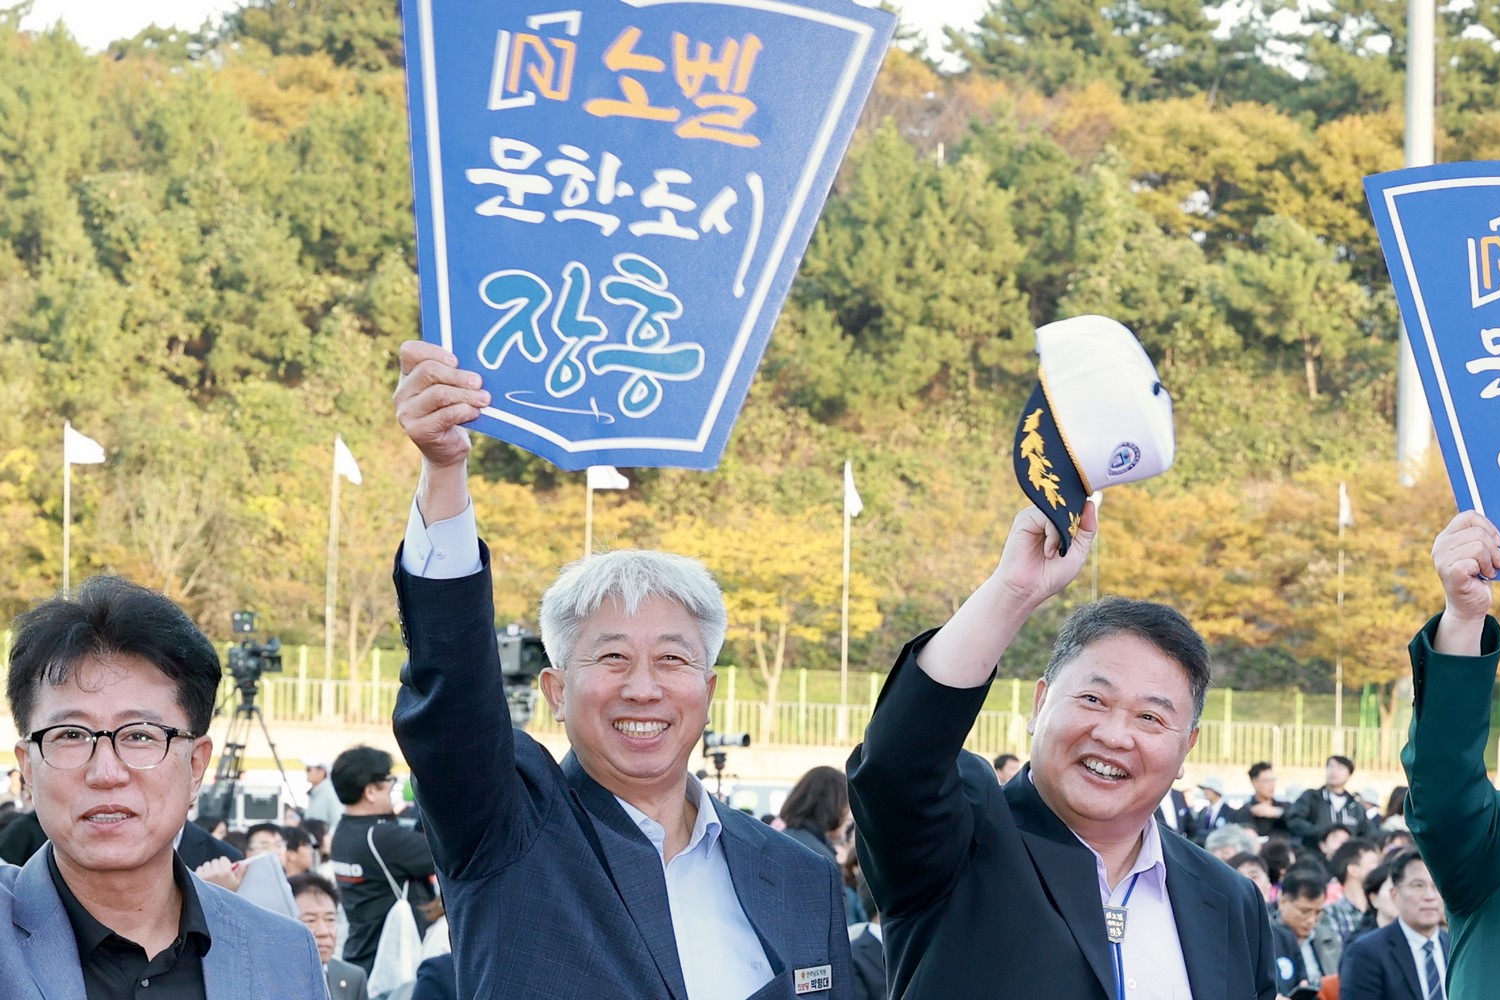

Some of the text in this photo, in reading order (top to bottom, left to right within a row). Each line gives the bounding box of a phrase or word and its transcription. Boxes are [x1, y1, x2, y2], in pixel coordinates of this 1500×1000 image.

[582, 26, 764, 149] 노벨
[465, 136, 765, 298] 문학도시
[477, 252, 705, 419] 장흥
